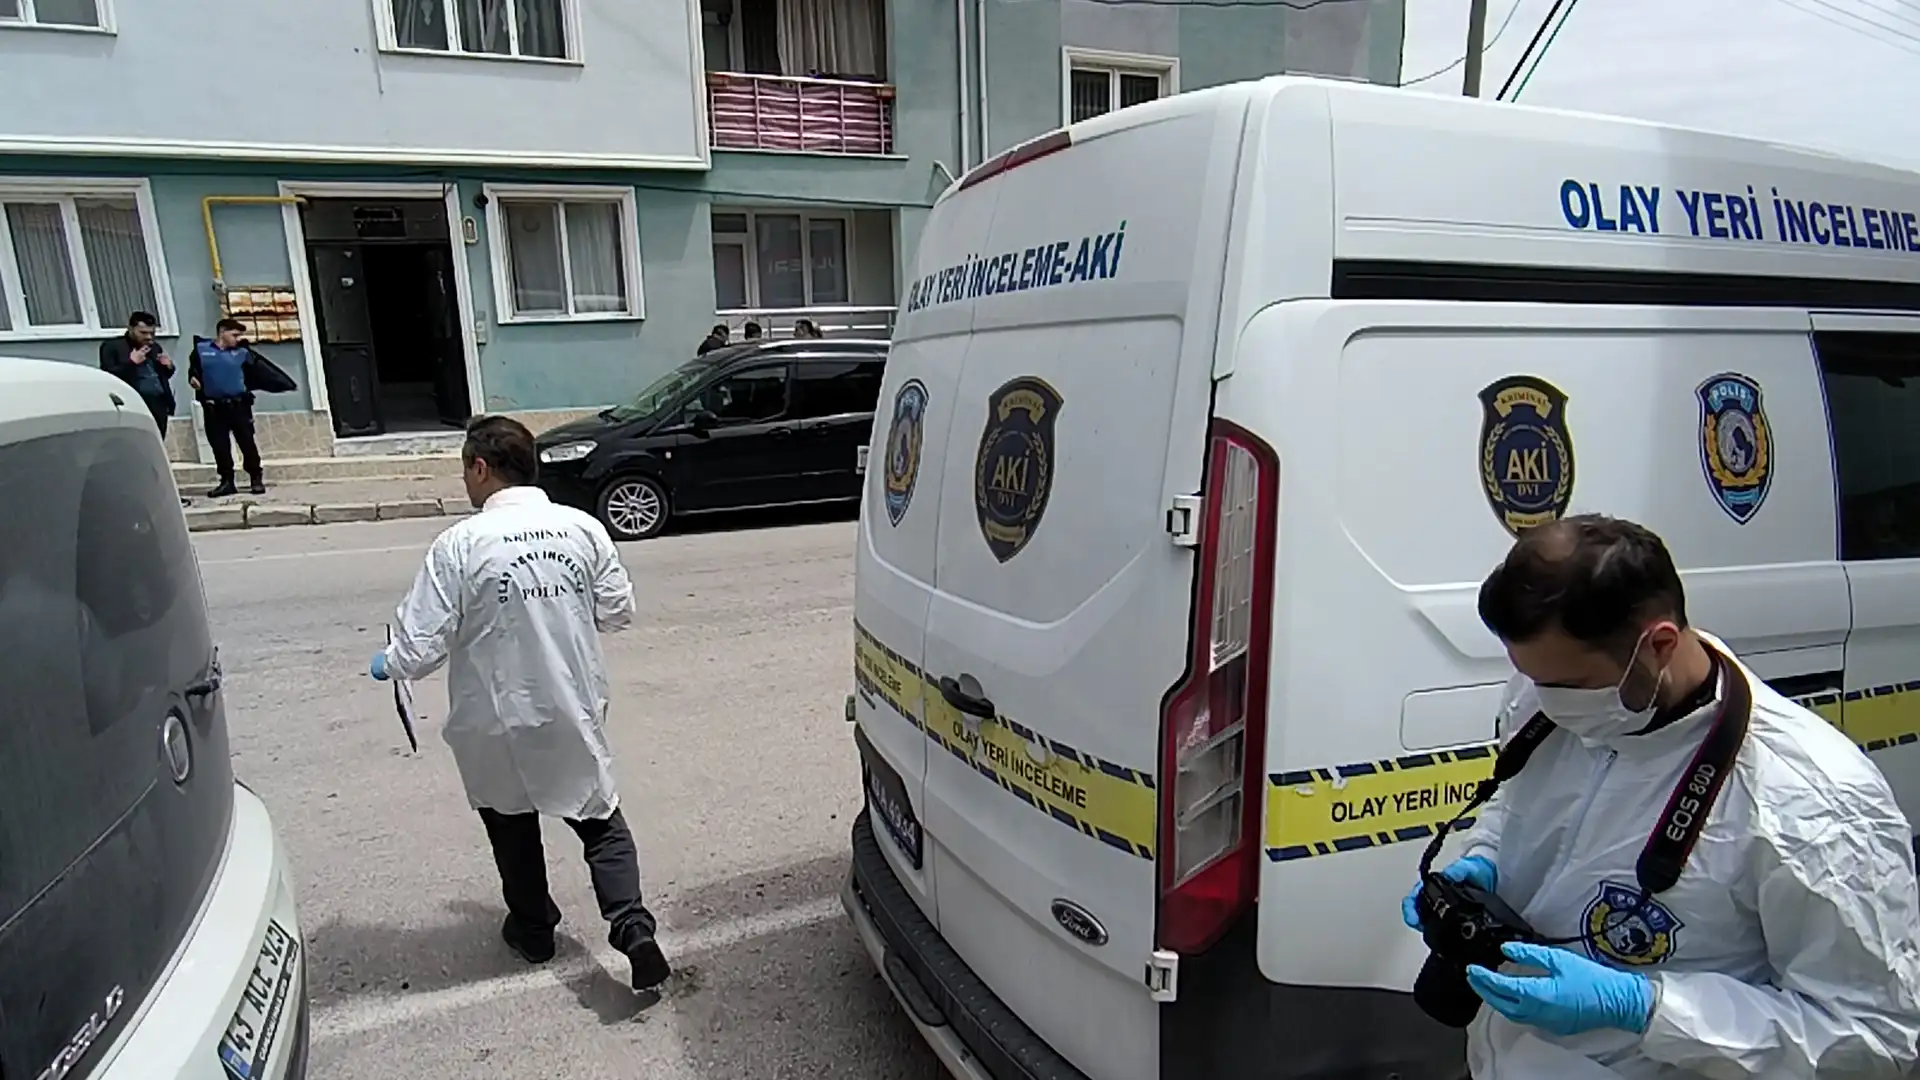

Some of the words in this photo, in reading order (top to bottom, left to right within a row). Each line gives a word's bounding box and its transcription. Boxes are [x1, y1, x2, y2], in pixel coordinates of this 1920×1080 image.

[1560, 179, 1660, 233] OLAY
[1675, 184, 1764, 240] YERİ
[1771, 186, 1920, 252] İNCELEME
[908, 270, 938, 313] OLAY
[936, 253, 971, 304] YERİ
[991, 450, 1030, 492] AKİ
[1506, 441, 1549, 481] AKİ
[952, 721, 979, 751] OLAY
[981, 739, 1009, 769] YERİ
[1010, 749, 1088, 809] İNCELEME
[1331, 795, 1388, 822] OLAY
[1392, 783, 1438, 813] YERİ
[1444, 781, 1477, 806] İNC
[1666, 795, 1700, 842] EOS
[1689, 763, 1717, 795] 80D
